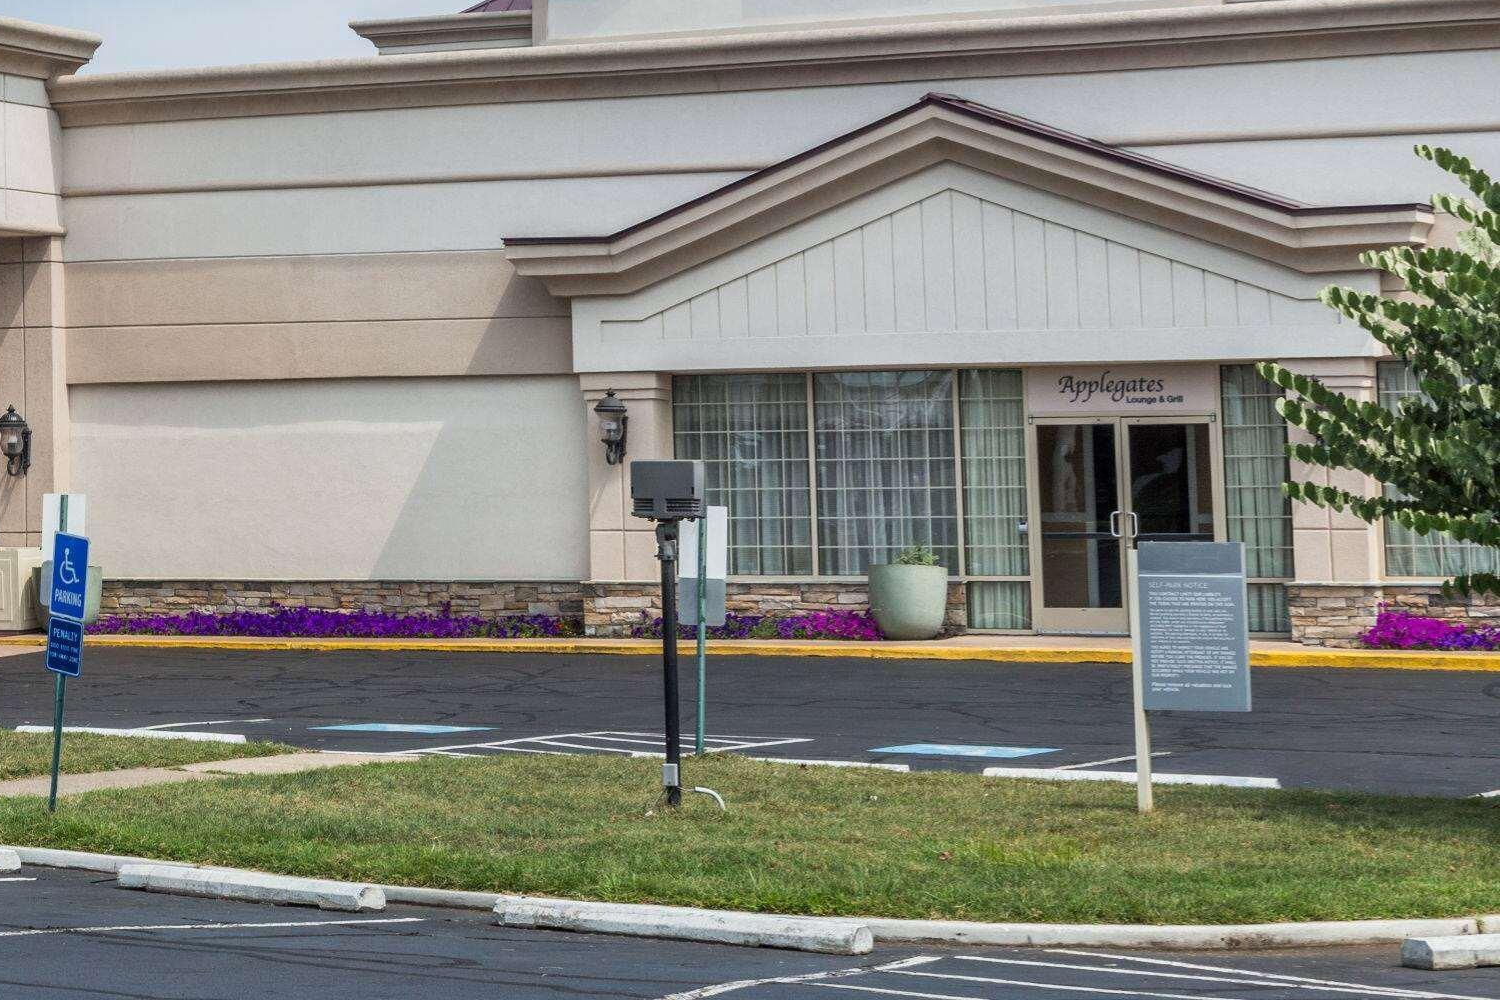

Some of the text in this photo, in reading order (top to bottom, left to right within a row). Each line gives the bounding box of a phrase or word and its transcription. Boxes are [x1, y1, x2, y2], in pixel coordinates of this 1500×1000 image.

[1058, 370, 1164, 403] Applegates
[1126, 395, 1158, 405] Lounge
[1166, 395, 1184, 403] Grill
[54, 588, 82, 607] PARKING
[53, 627, 78, 642] PENALTY
